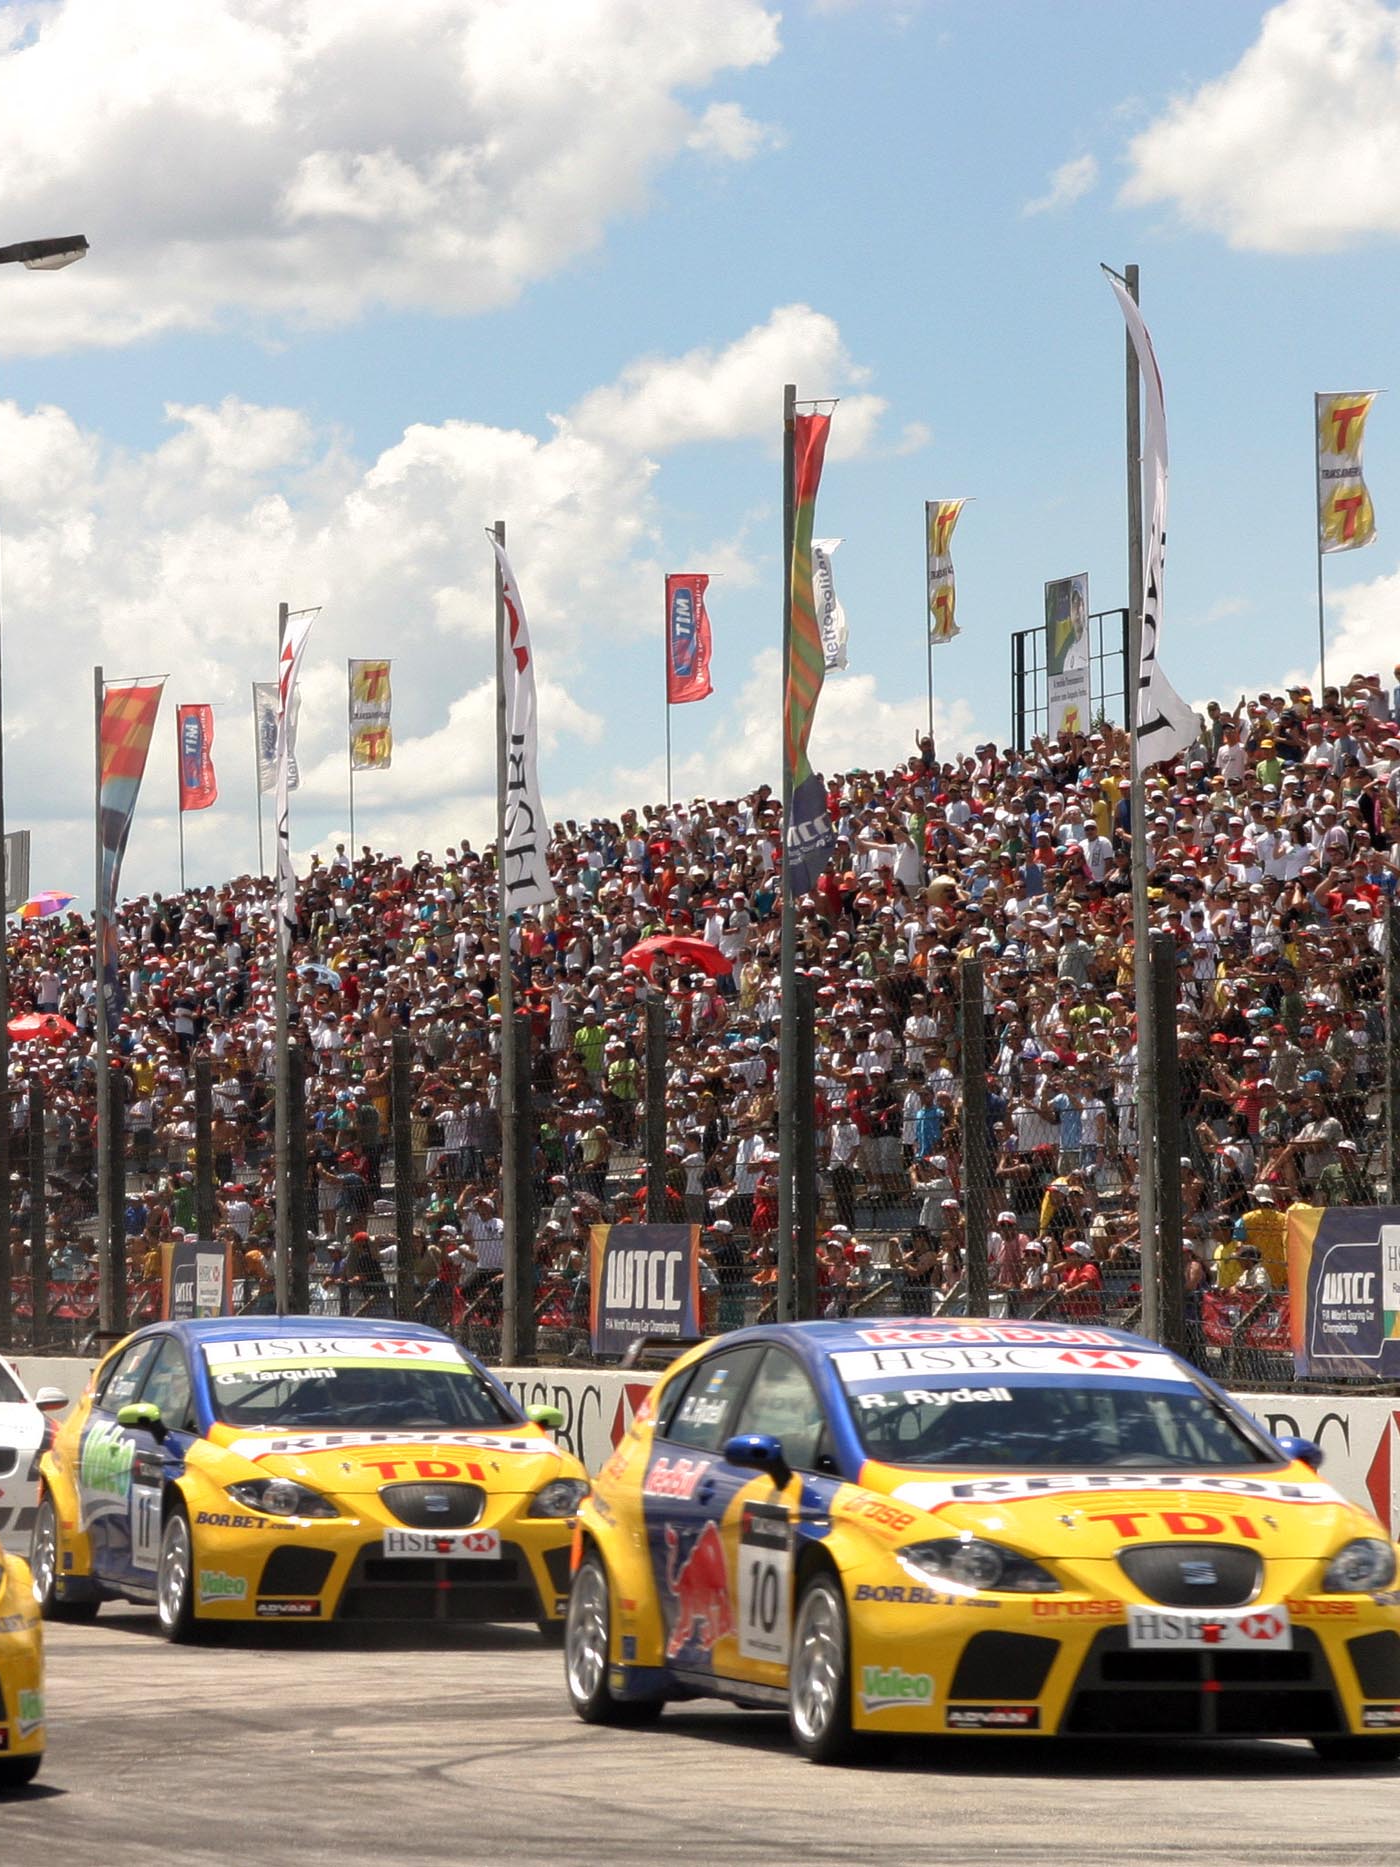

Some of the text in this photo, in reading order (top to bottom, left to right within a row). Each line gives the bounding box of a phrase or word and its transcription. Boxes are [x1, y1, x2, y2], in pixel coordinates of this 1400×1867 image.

[1332, 404, 1367, 451] T
[1334, 496, 1362, 541] T
[676, 599, 691, 636] TIM
[364, 669, 388, 702] T
[185, 724, 198, 754] TIM
[362, 731, 386, 760] T
[606, 1250, 682, 1310] WTCC
[1322, 1272, 1375, 1304] WTCC
[234, 1340, 357, 1357] HSBC
[862, 1328, 1118, 1345] Red Bull
[865, 1350, 1048, 1371] HSBC
[216, 1367, 337, 1386] G. Tarquini
[859, 1387, 1013, 1408] R. Rydell
[271, 1434, 533, 1451] REPSOL
[362, 1460, 486, 1481] TDI
[952, 1476, 1321, 1499] REPSOL
[139, 1496, 150, 1548] 11
[841, 1493, 917, 1531] brose
[1088, 1512, 1261, 1540] TDI
[201, 1573, 246, 1596] Valeo
[749, 1561, 779, 1633] 10
[258, 1602, 312, 1612] ADVAN
[1032, 1598, 1122, 1616] brose
[1283, 1595, 1357, 1615] brose
[863, 1666, 932, 1698] Valeo
[949, 1711, 1028, 1723] ADVAN
